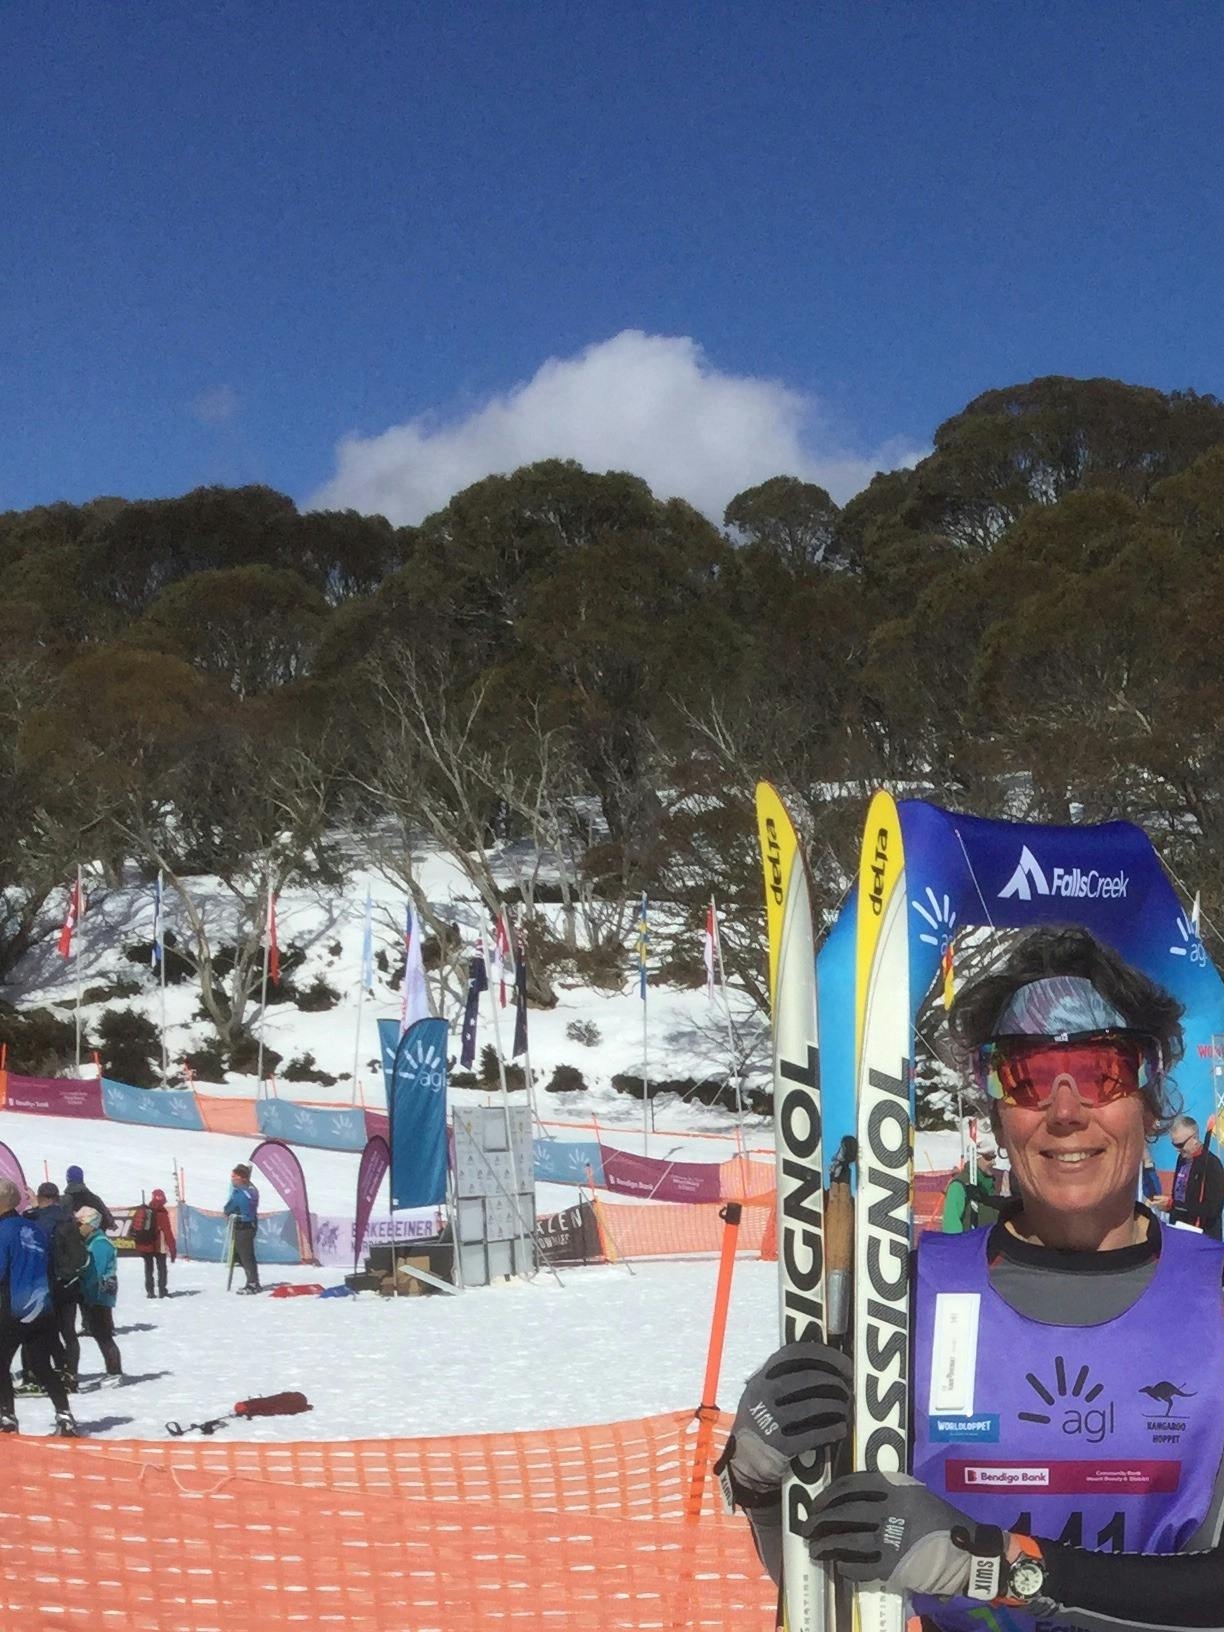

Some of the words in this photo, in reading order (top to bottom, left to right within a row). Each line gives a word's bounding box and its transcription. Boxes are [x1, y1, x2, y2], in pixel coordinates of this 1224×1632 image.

[1051, 867, 1130, 898] FallsCreek
[419, 1067, 447, 1093] agl
[864, 1057, 910, 1472] OSSIGNOL
[749, 1401, 780, 1436] SWIX
[1062, 1400, 1115, 1444] agl
[1147, 1421, 1187, 1432] KANGAROO
[1152, 1434, 1181, 1444] HOPPET
[980, 1471, 1019, 1484] Bendigo
[1022, 1472, 1047, 1483] Bank
[974, 1559, 995, 1595] SWIX
